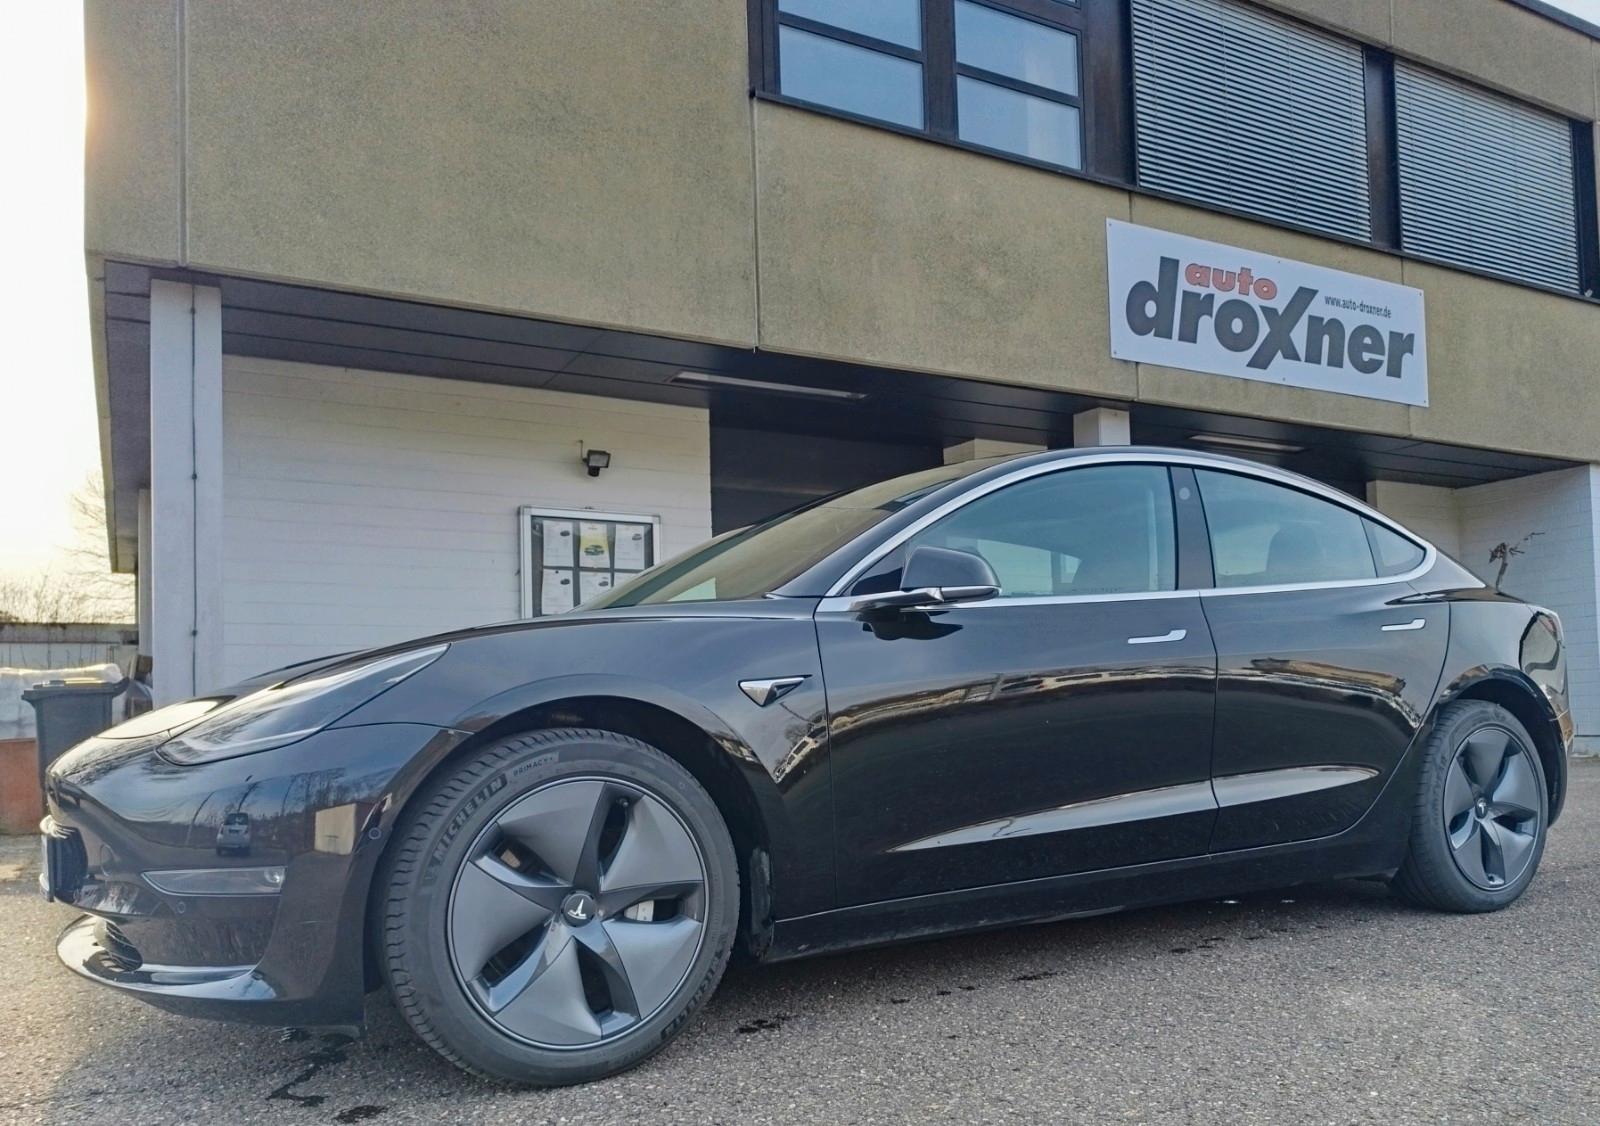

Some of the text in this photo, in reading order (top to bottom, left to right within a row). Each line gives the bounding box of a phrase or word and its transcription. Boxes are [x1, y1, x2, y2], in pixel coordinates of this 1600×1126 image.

[1185, 263, 1278, 301] auto
[1324, 295, 1392, 319] www.auto-droxner.de
[433, 775, 506, 862] MICHELIN
